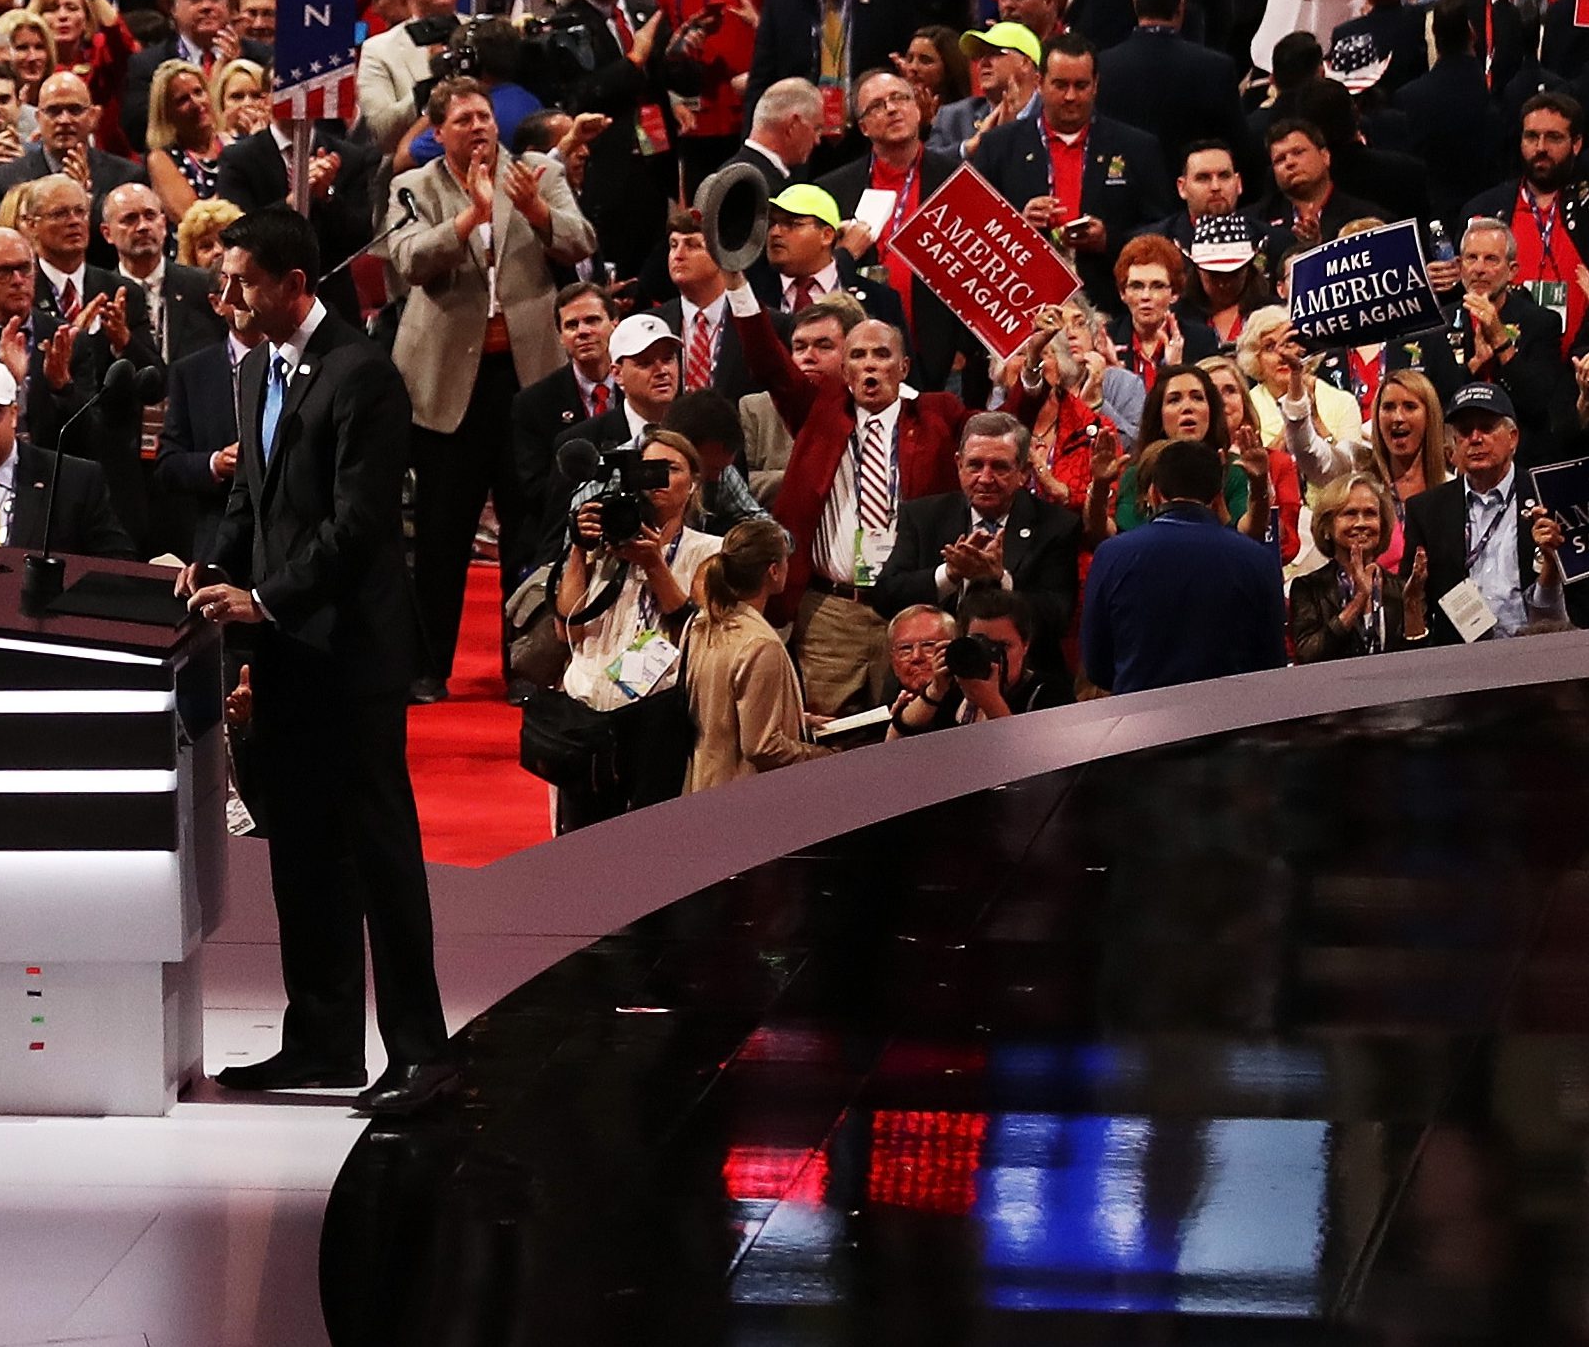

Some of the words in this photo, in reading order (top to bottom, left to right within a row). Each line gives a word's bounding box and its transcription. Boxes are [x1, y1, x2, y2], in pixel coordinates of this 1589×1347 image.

[922, 203, 1047, 319] AMERICA
[983, 217, 1033, 267] MAKE
[1326, 250, 1372, 277] MAKE
[916, 231, 965, 278] SAFE
[960, 277, 1021, 335] AGAIN
[1290, 264, 1426, 322] AMERICA
[1301, 313, 1352, 340] SAFE
[1358, 296, 1423, 328] AGAIN
